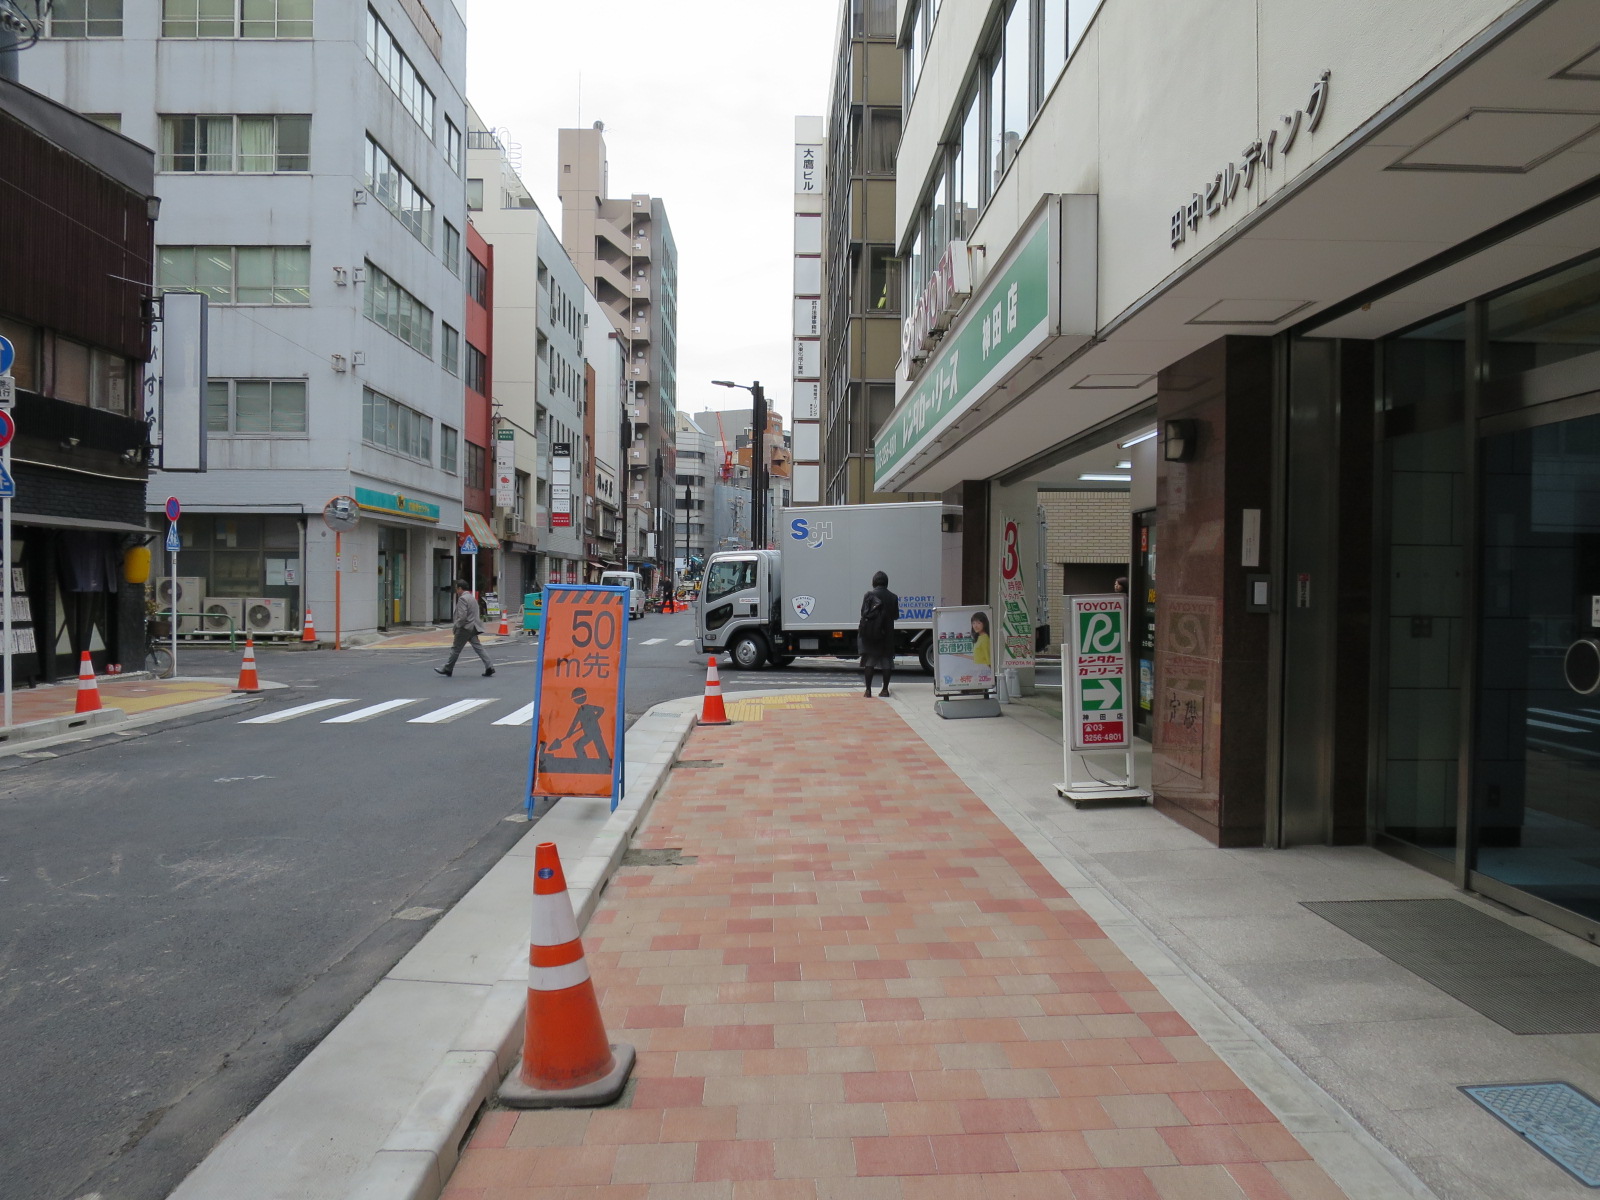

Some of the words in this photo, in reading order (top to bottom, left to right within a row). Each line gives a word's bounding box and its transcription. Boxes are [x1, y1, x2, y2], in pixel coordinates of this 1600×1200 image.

[803, 148, 814, 190] 大鷹ビル
[981, 281, 1018, 361] 神田店
[1003, 521, 1018, 579] 3
[1008, 581, 1023, 591] 時間
[1077, 602, 1122, 612] TOYOTA
[571, 610, 615, 649] 50
[556, 652, 610, 679] m先
[1078, 655, 1123, 664] レンタカー
[1078, 666, 1123, 676] カーリース
[1084, 733, 1122, 742] 3256-4801
